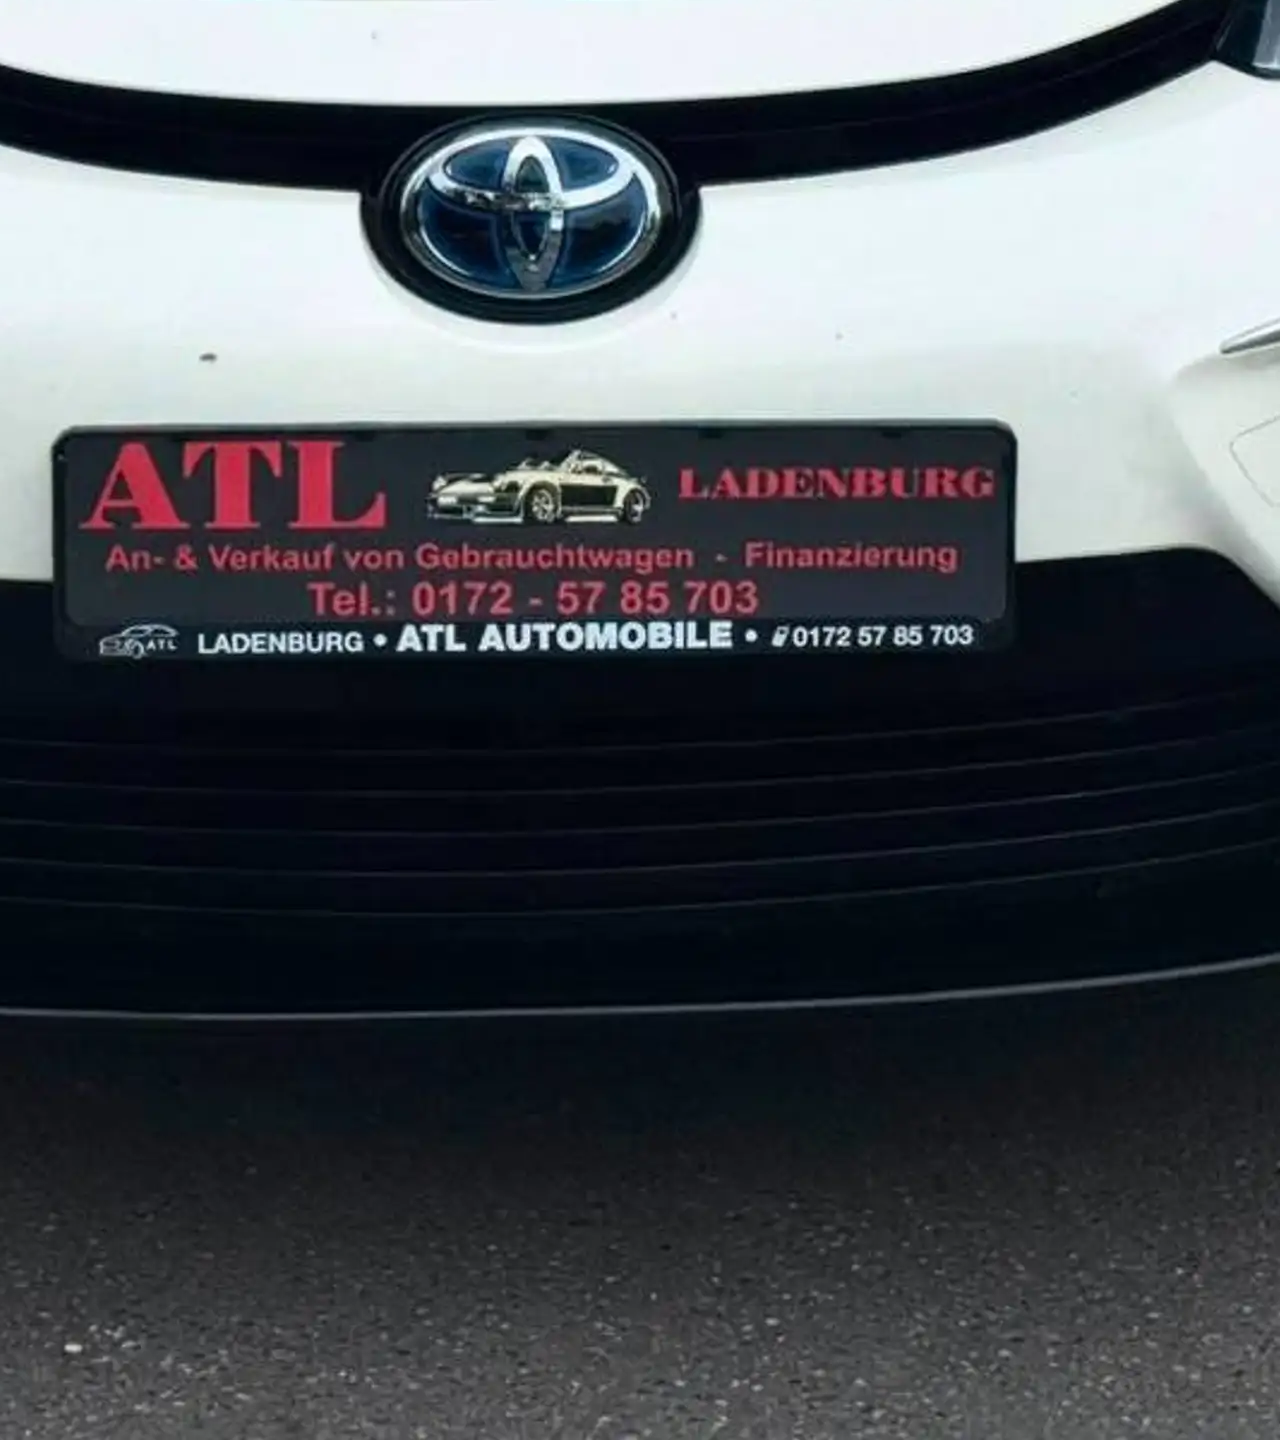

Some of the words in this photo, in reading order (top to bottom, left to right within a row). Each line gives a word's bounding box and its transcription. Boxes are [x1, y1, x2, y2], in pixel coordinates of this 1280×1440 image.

[78, 440, 387, 530] ATL
[678, 467, 995, 499] LADENBURG
[105, 544, 164, 572] An-
[173, 544, 198, 571] &
[208, 543, 335, 571] Verkauf
[343, 549, 404, 571] von
[416, 543, 693, 575] Gebrauchtwagen
[745, 541, 958, 574] Finanzierung
[306, 582, 395, 616] Tel.:
[412, 581, 513, 615] 0172
[556, 581, 606, 615] 57
[620, 581, 670, 615] 85
[683, 581, 758, 614] 703
[198, 631, 363, 654] LADENBURG
[396, 624, 466, 652] ATL
[478, 620, 733, 652] AUTOMOBILE
[792, 626, 851, 647] 0172
[856, 626, 886, 647] 57
[893, 625, 922, 646] 85
[930, 624, 974, 645] 703
